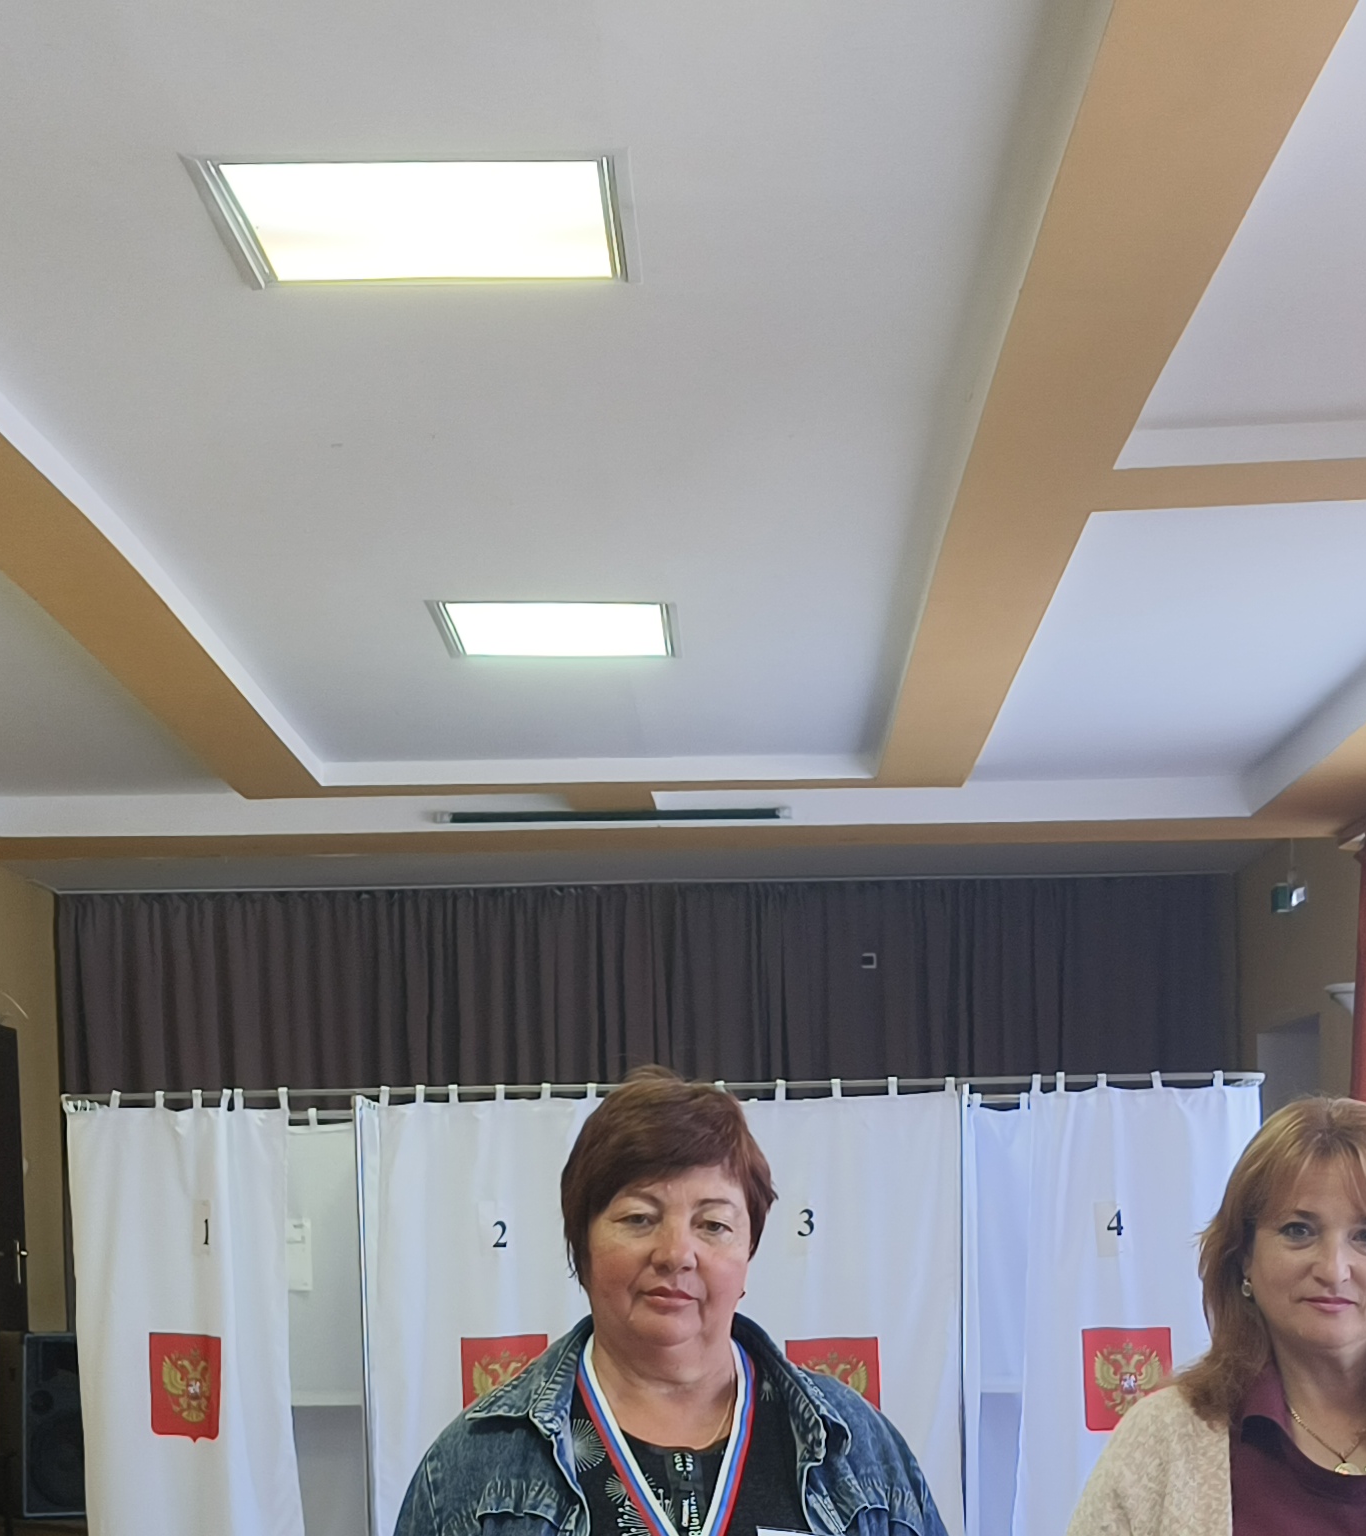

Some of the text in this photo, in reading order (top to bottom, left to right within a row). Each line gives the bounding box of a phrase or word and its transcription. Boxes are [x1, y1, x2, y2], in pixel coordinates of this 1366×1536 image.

[203, 1218, 210, 1246] 1
[492, 1220, 508, 1248] 2
[797, 1208, 815, 1237] 3
[1106, 1209, 1124, 1236] 4
